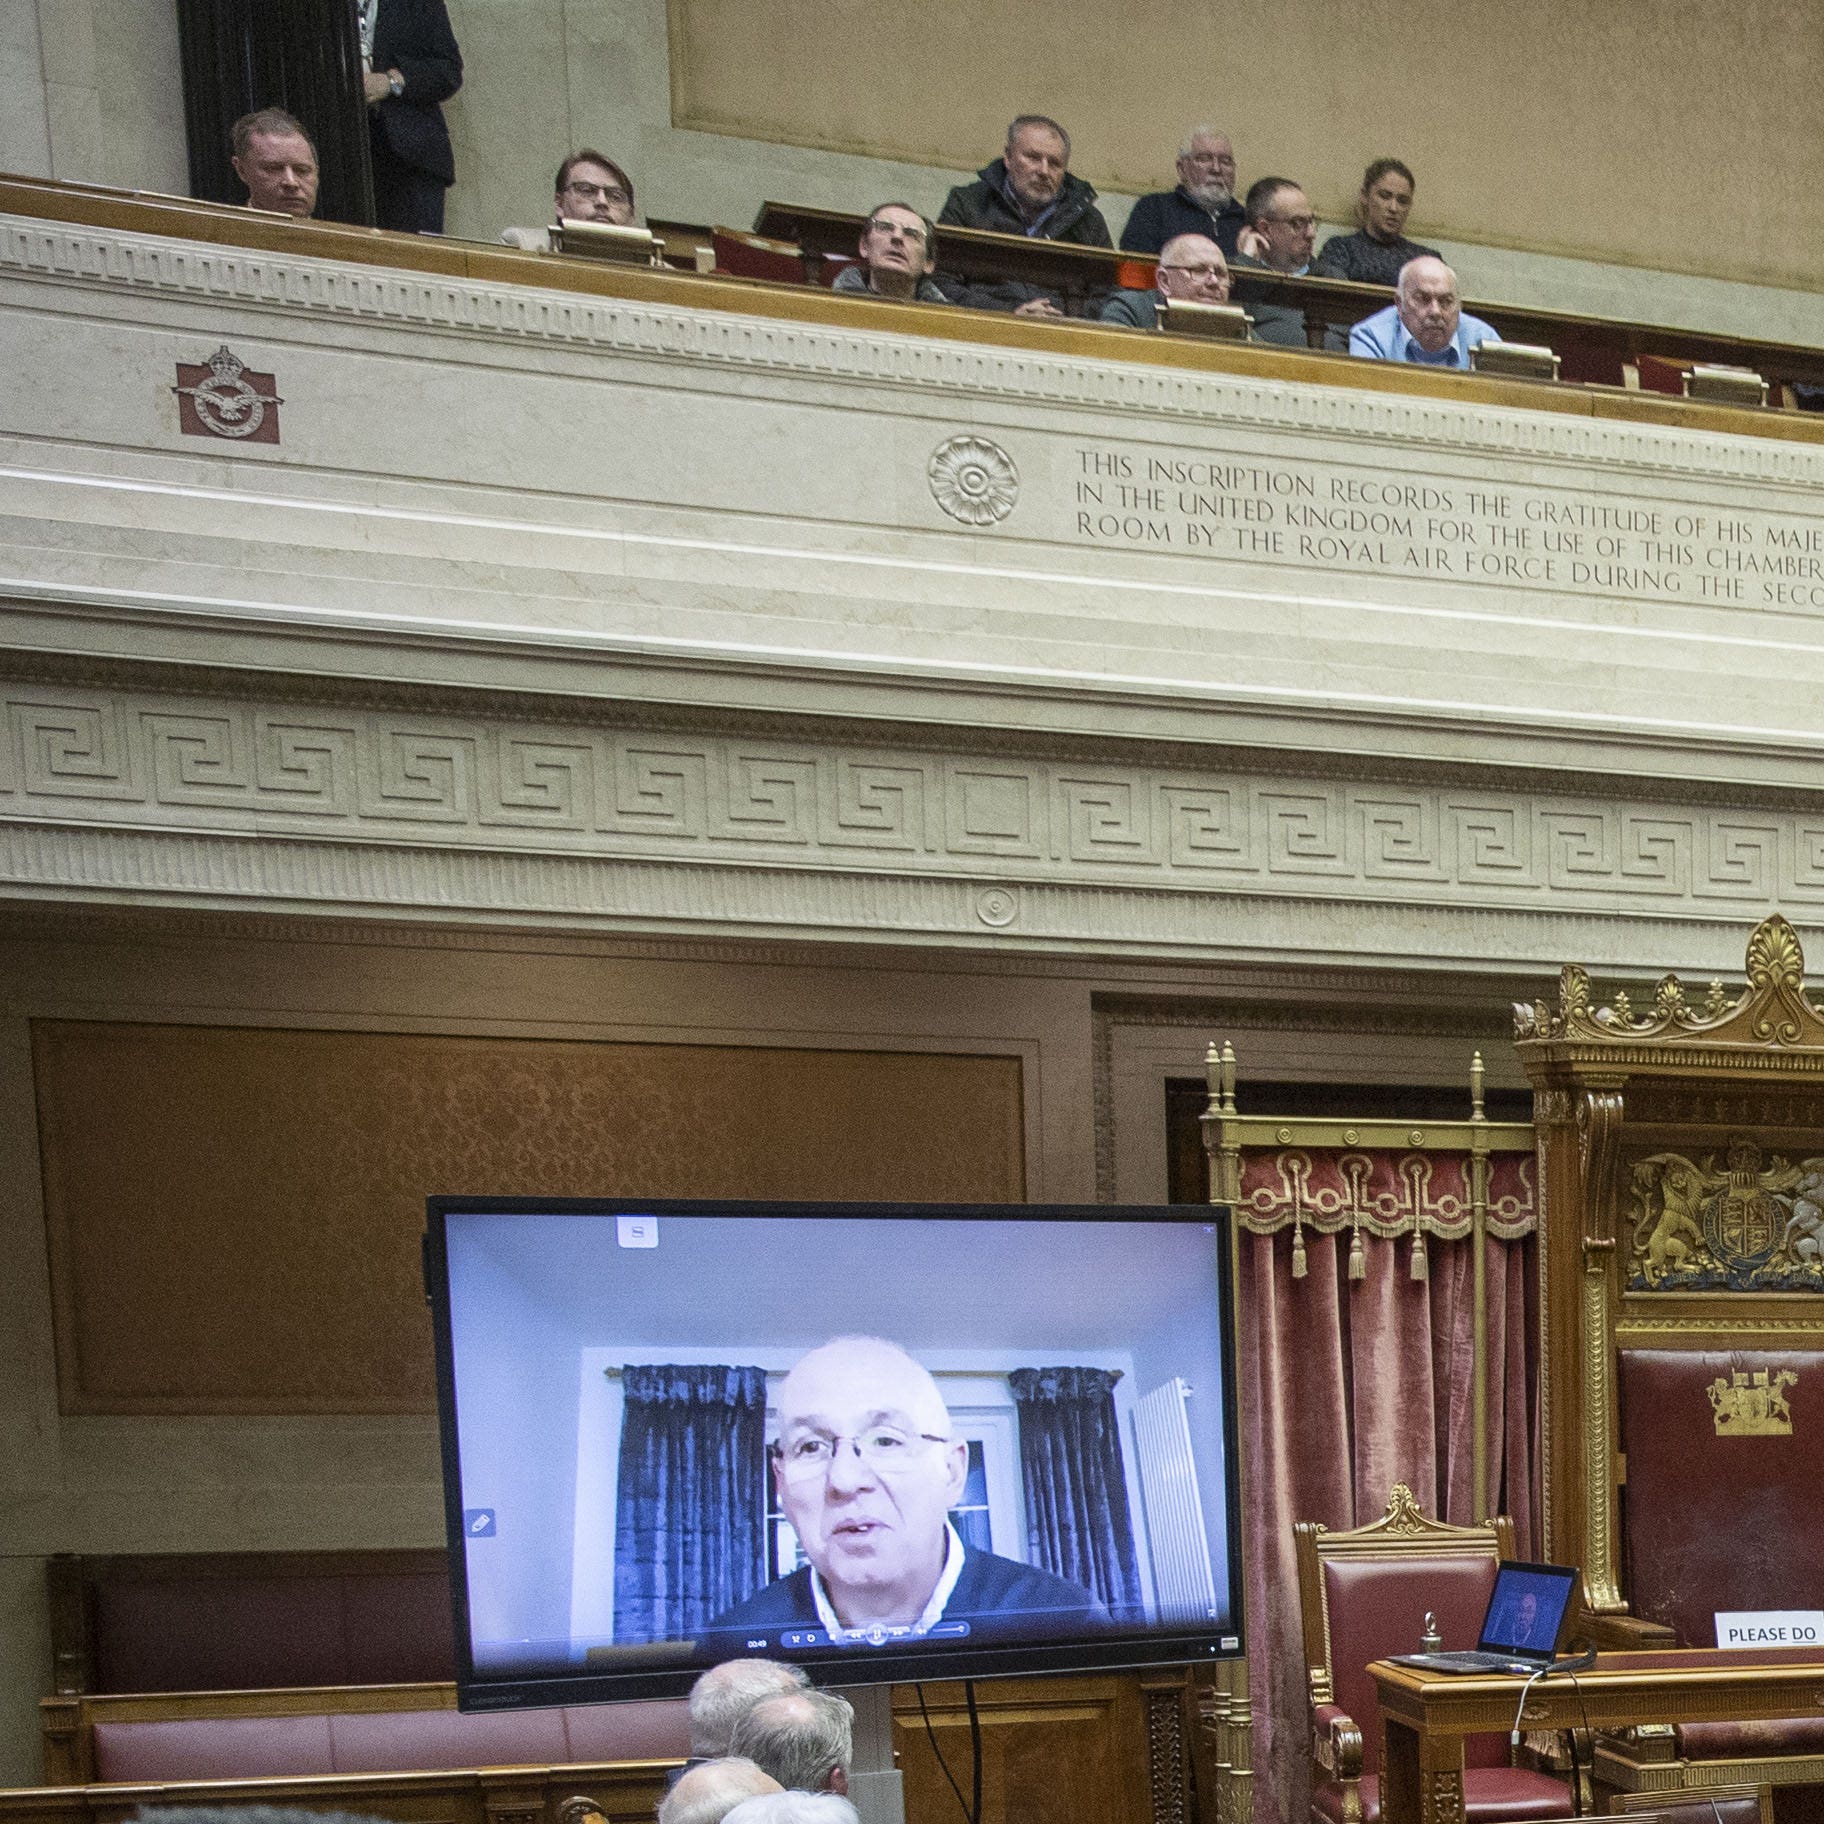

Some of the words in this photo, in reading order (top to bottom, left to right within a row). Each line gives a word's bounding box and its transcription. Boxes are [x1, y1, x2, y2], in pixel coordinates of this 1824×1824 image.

[1076, 450, 1133, 478] THIS
[1148, 458, 1314, 497] INSCRIPTION
[1331, 478, 1453, 511] RECORDS
[1466, 493, 1510, 518] THE
[1524, 501, 1661, 536] GRATITUDE
[1674, 516, 1705, 538] OF
[1718, 520, 1753, 543] HIS
[1076, 481, 1103, 504] IN
[1116, 484, 1165, 512] THE
[1178, 492, 1274, 523] UNITED
[1286, 503, 1412, 537] KINGDOM
[1428, 518, 1476, 544] FOR
[1487, 524, 1531, 549] THE
[1543, 530, 1583, 555] USE
[1596, 537, 1626, 558] OF
[1640, 540, 1693, 566] THIS
[1706, 548, 1824, 581] CHAMBER
[1077, 511, 1171, 543] ROOM
[1187, 523, 1220, 547] BY
[1233, 528, 1283, 554] THE
[1300, 534, 1390, 564] ROYAL
[1404, 547, 1453, 572] AIR
[1466, 551, 1555, 581] FORCE
[1572, 561, 1680, 592] DURING
[1696, 575, 1743, 599] THE
[1729, 1627, 1788, 1642] PLEASE
[1792, 1626, 1817, 1641] DO
